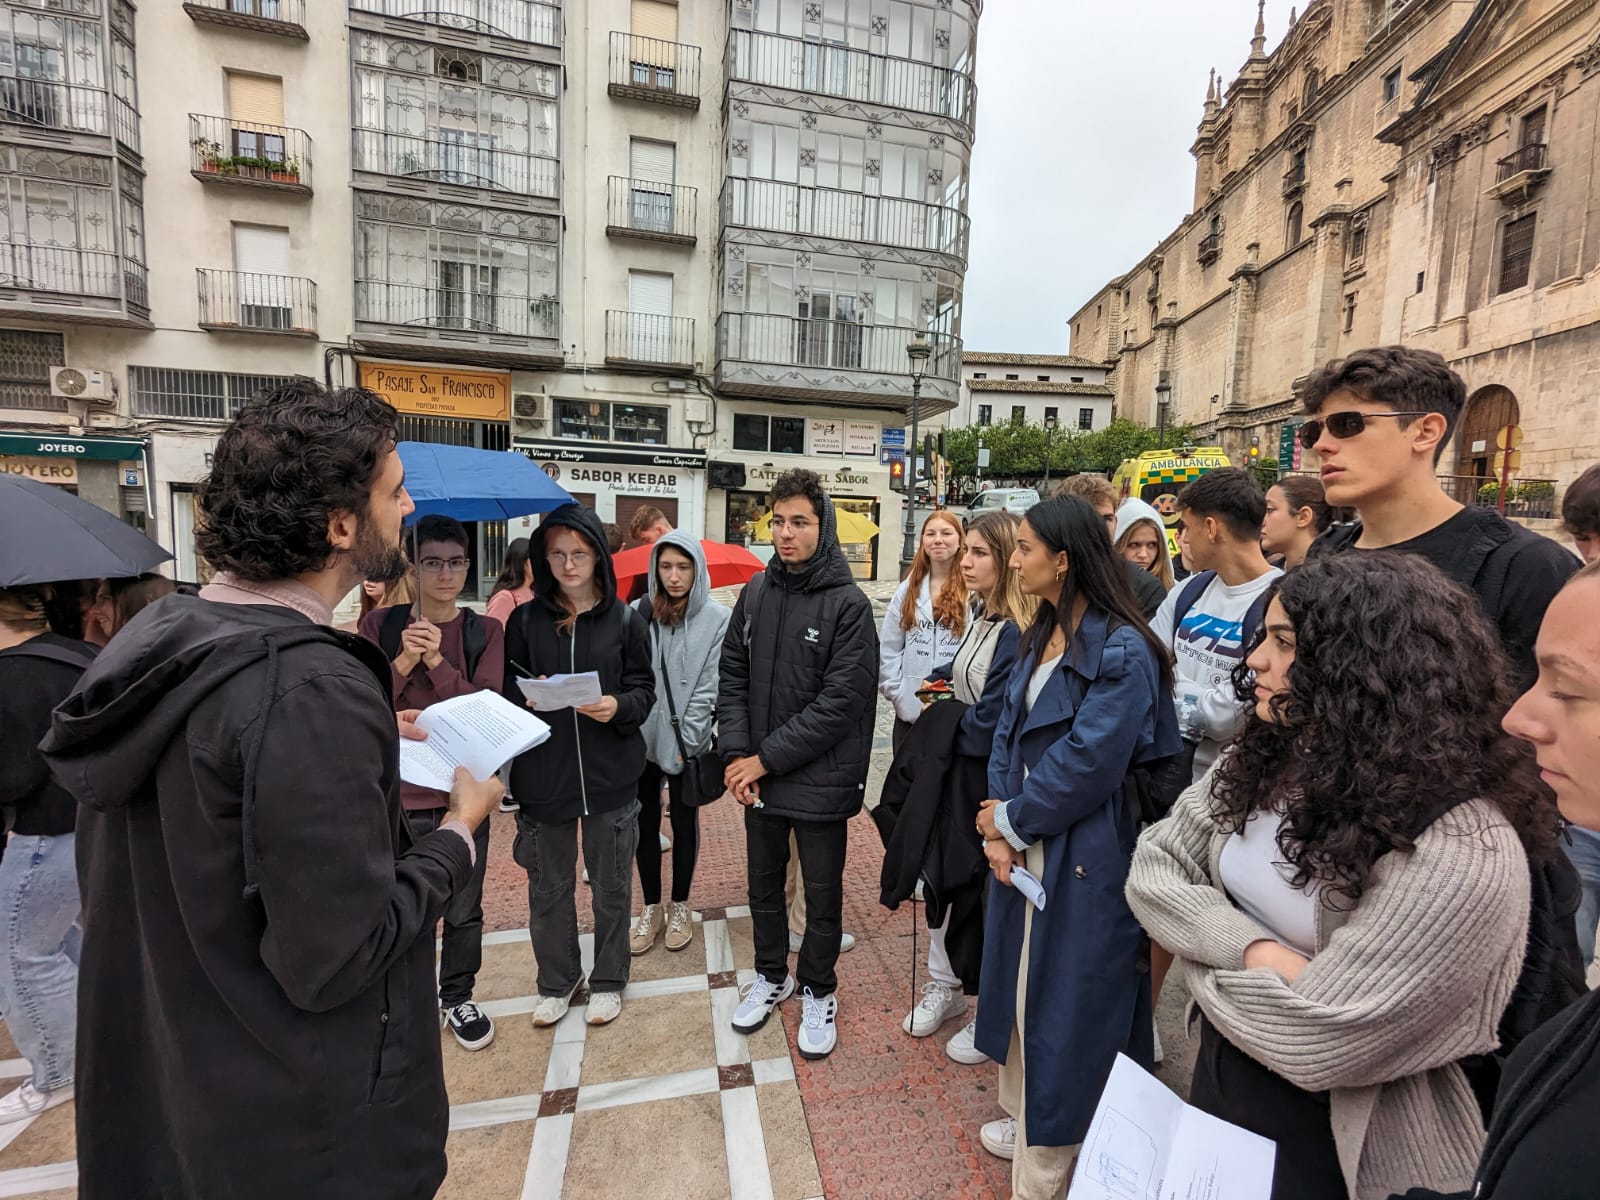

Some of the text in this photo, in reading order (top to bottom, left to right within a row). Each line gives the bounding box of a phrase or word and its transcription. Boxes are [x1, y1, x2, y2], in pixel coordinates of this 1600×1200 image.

[37, 443, 86, 453] JOYERO
[1150, 458, 1222, 470] AMBULANCIA
[1, 463, 74, 478] JOYERO
[571, 468, 622, 483] SABOR
[628, 472, 677, 486] KEBAB
[835, 472, 869, 484] SABOR
[916, 649, 930, 657] NEW
